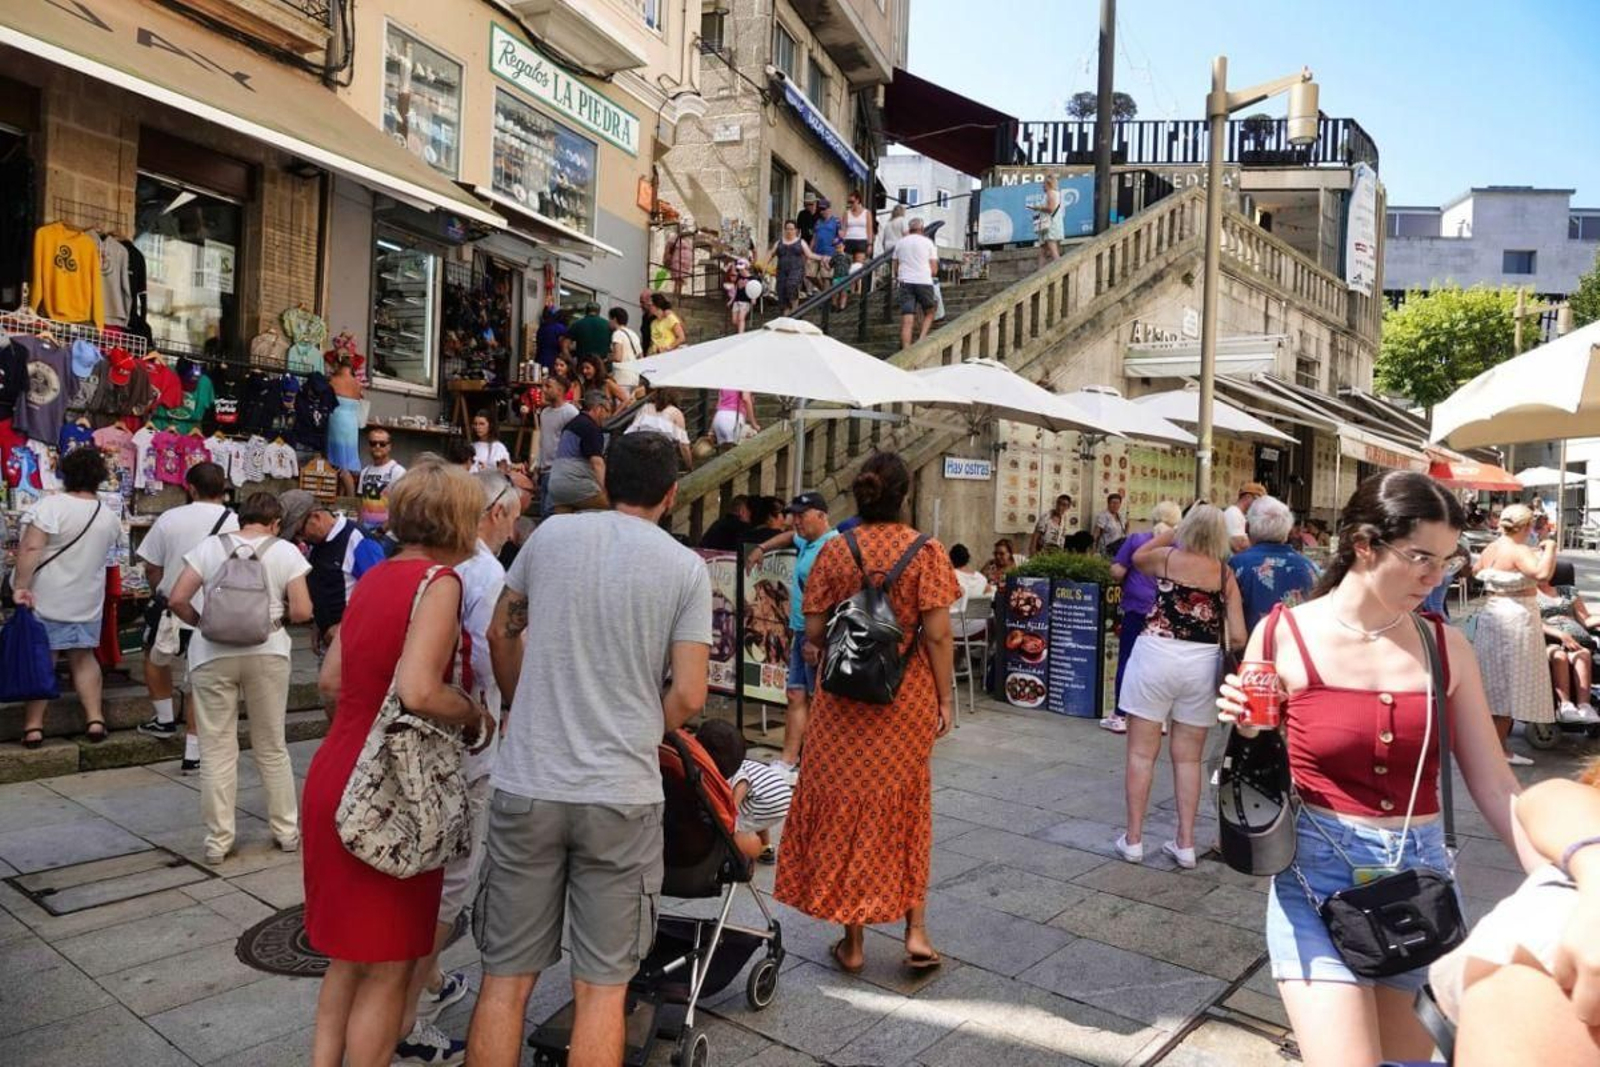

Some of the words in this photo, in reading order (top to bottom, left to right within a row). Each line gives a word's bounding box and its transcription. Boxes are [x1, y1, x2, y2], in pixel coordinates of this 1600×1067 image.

[499, 38, 550, 88] Regalos
[553, 71, 574, 110] LA
[578, 88, 631, 145] PIEDRA
[947, 459, 964, 475] Hay
[964, 462, 990, 476] ostras
